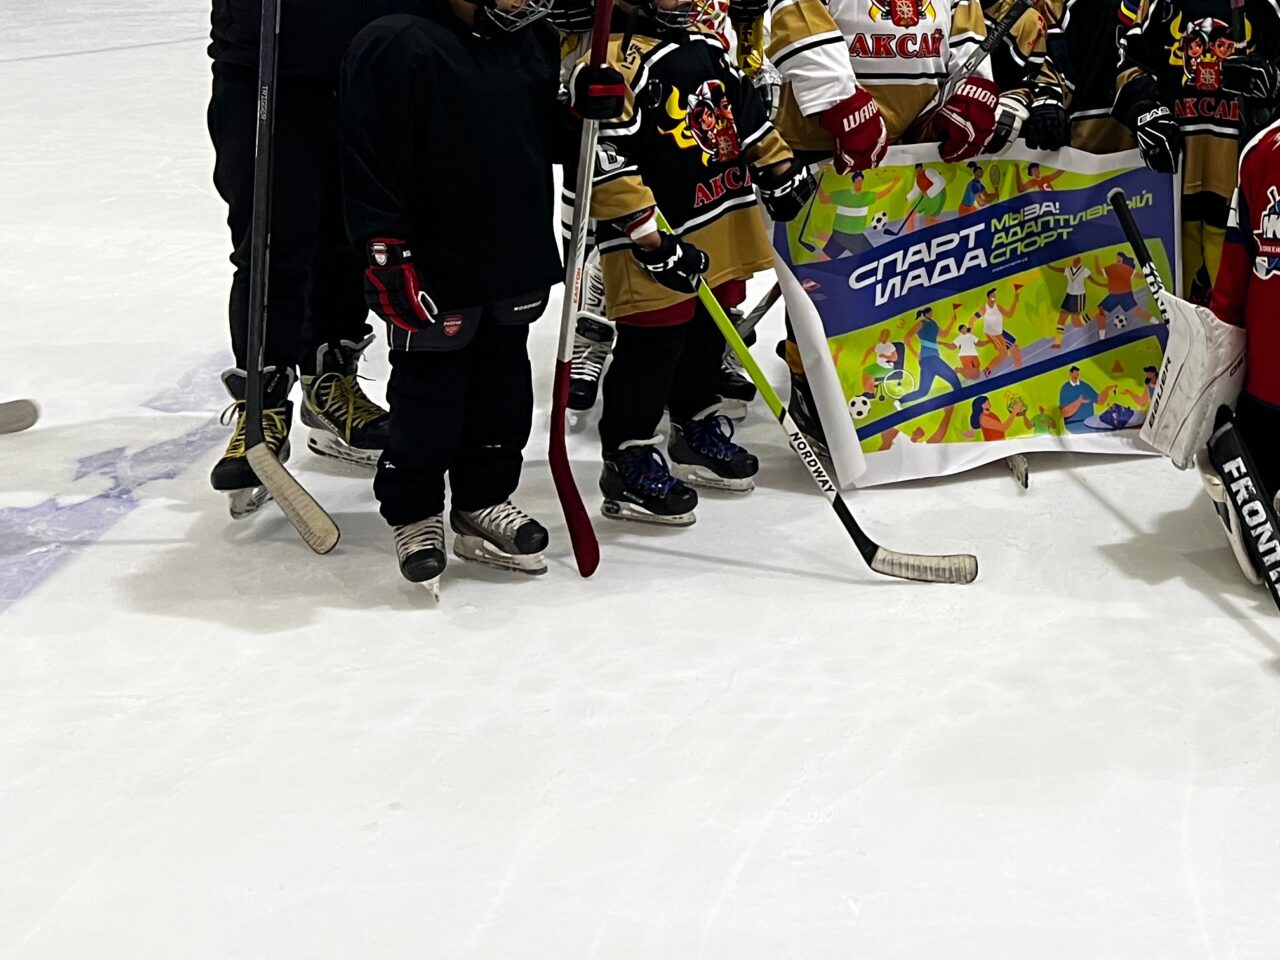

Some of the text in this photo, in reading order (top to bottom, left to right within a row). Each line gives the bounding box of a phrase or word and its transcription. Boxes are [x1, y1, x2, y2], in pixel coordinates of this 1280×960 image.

[850, 28, 944, 59] АКСАЙ
[848, 223, 986, 290] СПАРТ
[989, 227, 1073, 265] СПОРТ
[573, 267, 581, 304] EASTON
[874, 247, 988, 307] ИАДА
[789, 431, 836, 493] NORDWAY
